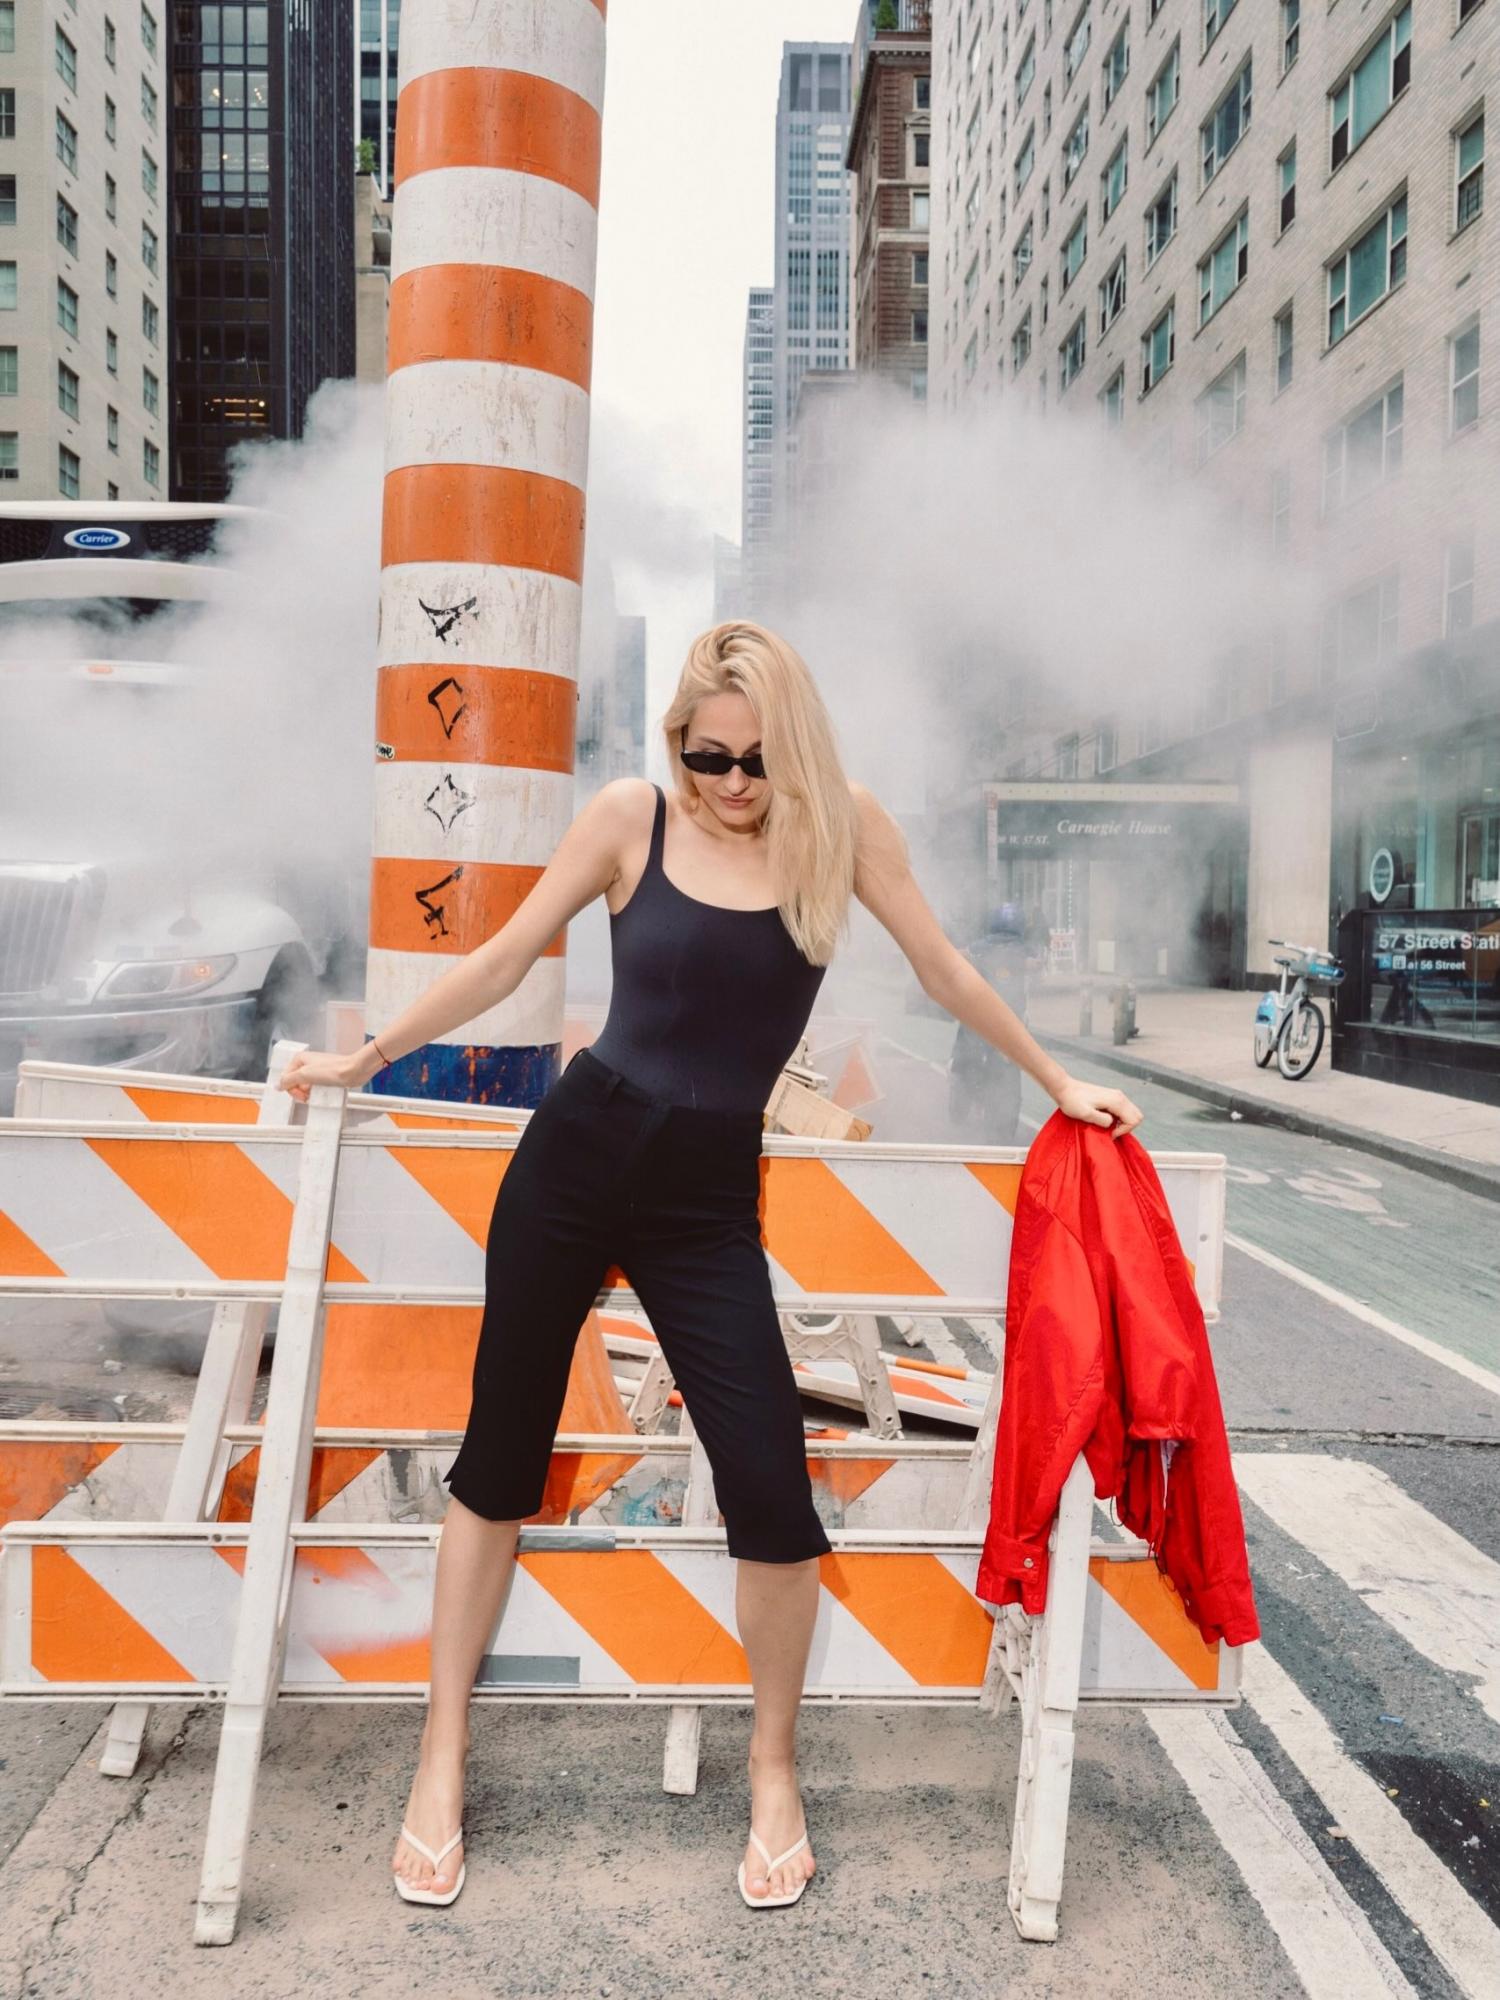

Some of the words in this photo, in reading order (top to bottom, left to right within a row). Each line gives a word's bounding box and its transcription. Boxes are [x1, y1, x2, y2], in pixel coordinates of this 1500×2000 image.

[79, 534, 114, 543] Carrier
[1057, 820, 1121, 836] Carnegie
[1128, 820, 1171, 834] House
[1379, 935, 1399, 949] 57
[1404, 934, 1456, 949] Street
[1407, 961, 1418, 970] at
[1420, 960, 1433, 970] 56
[1435, 960, 1466, 970] Street
